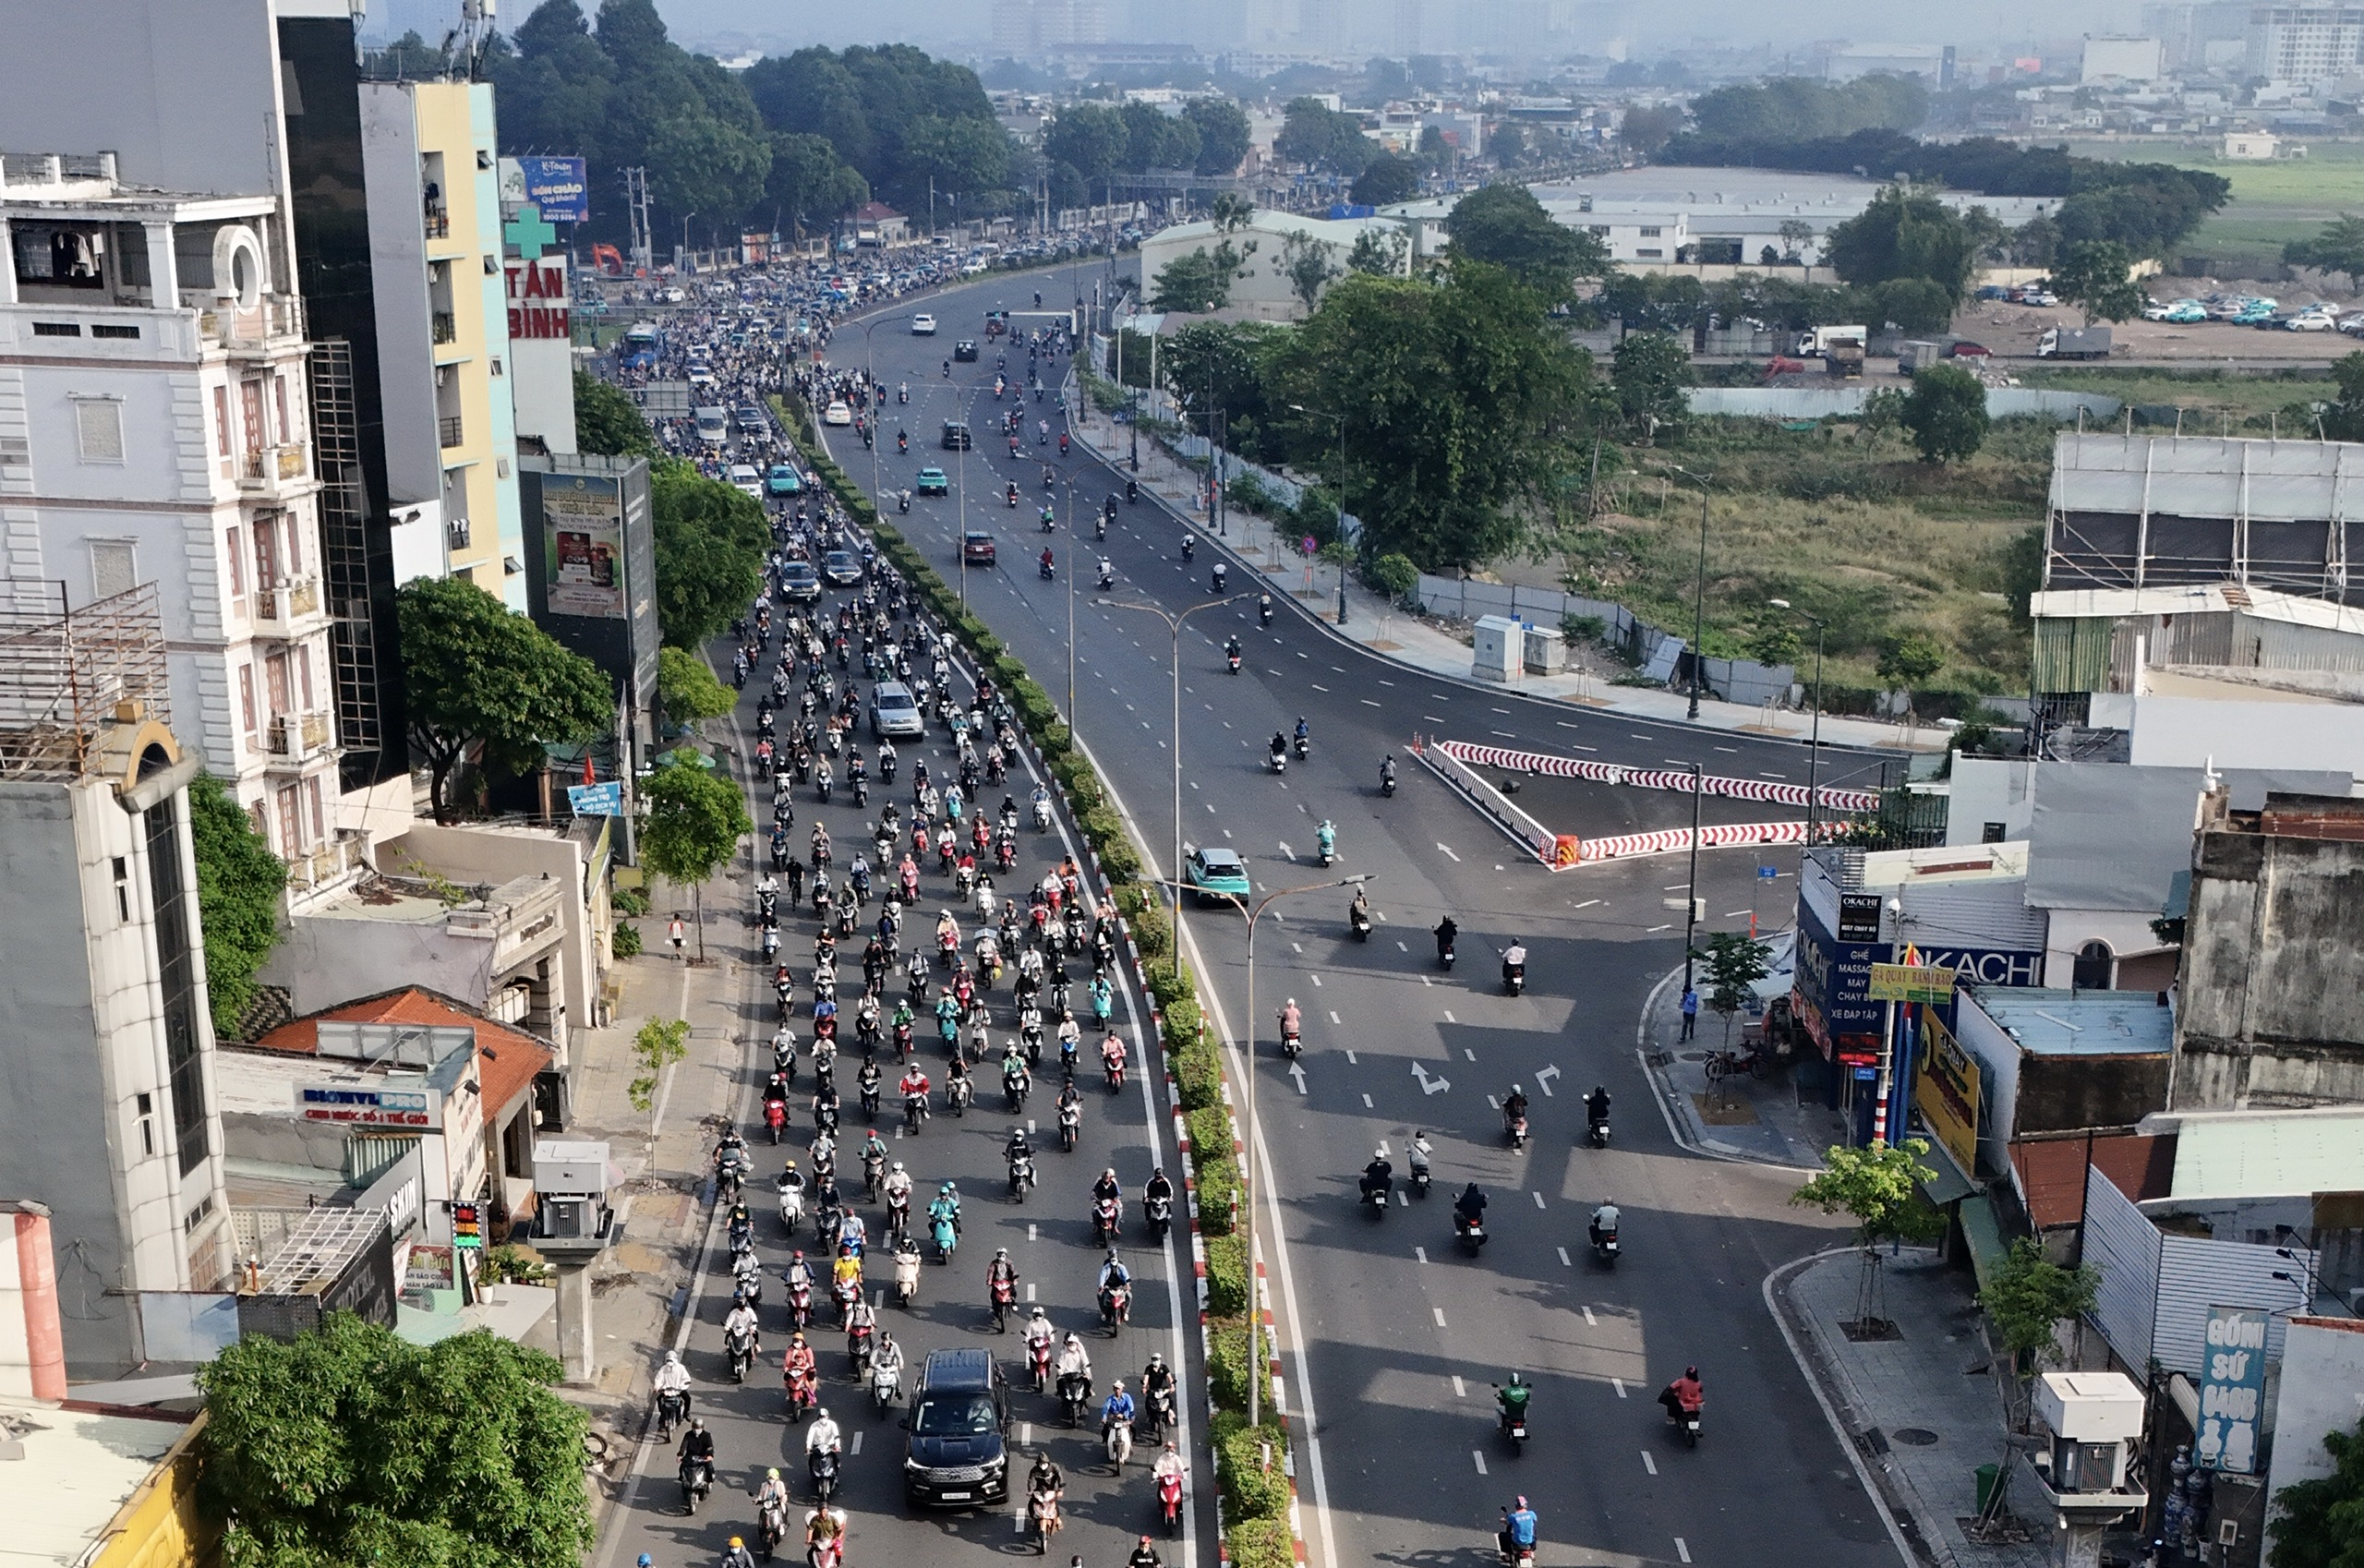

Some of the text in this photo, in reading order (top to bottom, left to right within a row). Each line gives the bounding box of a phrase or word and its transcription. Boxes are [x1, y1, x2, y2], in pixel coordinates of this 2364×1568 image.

[552, 182, 583, 194] CHÀO
[505, 259, 563, 297] TÂN
[508, 301, 569, 338] BÌNH
[1842, 897, 1879, 907] OKACHI
[1850, 947, 1869, 960] GHẾ
[1839, 964, 1872, 974] MASSAG
[1838, 991, 1862, 1003] CHẠY
[1831, 1008, 1877, 1022] XE ĐẠP TẬP
[381, 1093, 426, 1108] PRO
[363, 1108, 377, 1122] SỐ
[380, 1114, 383, 1123] 1
[387, 1110, 405, 1125] THẾ
[390, 1176, 416, 1228] SKIN
[2207, 1312, 2265, 1349] GỐM
[2211, 1350, 2250, 1381] SỨ
